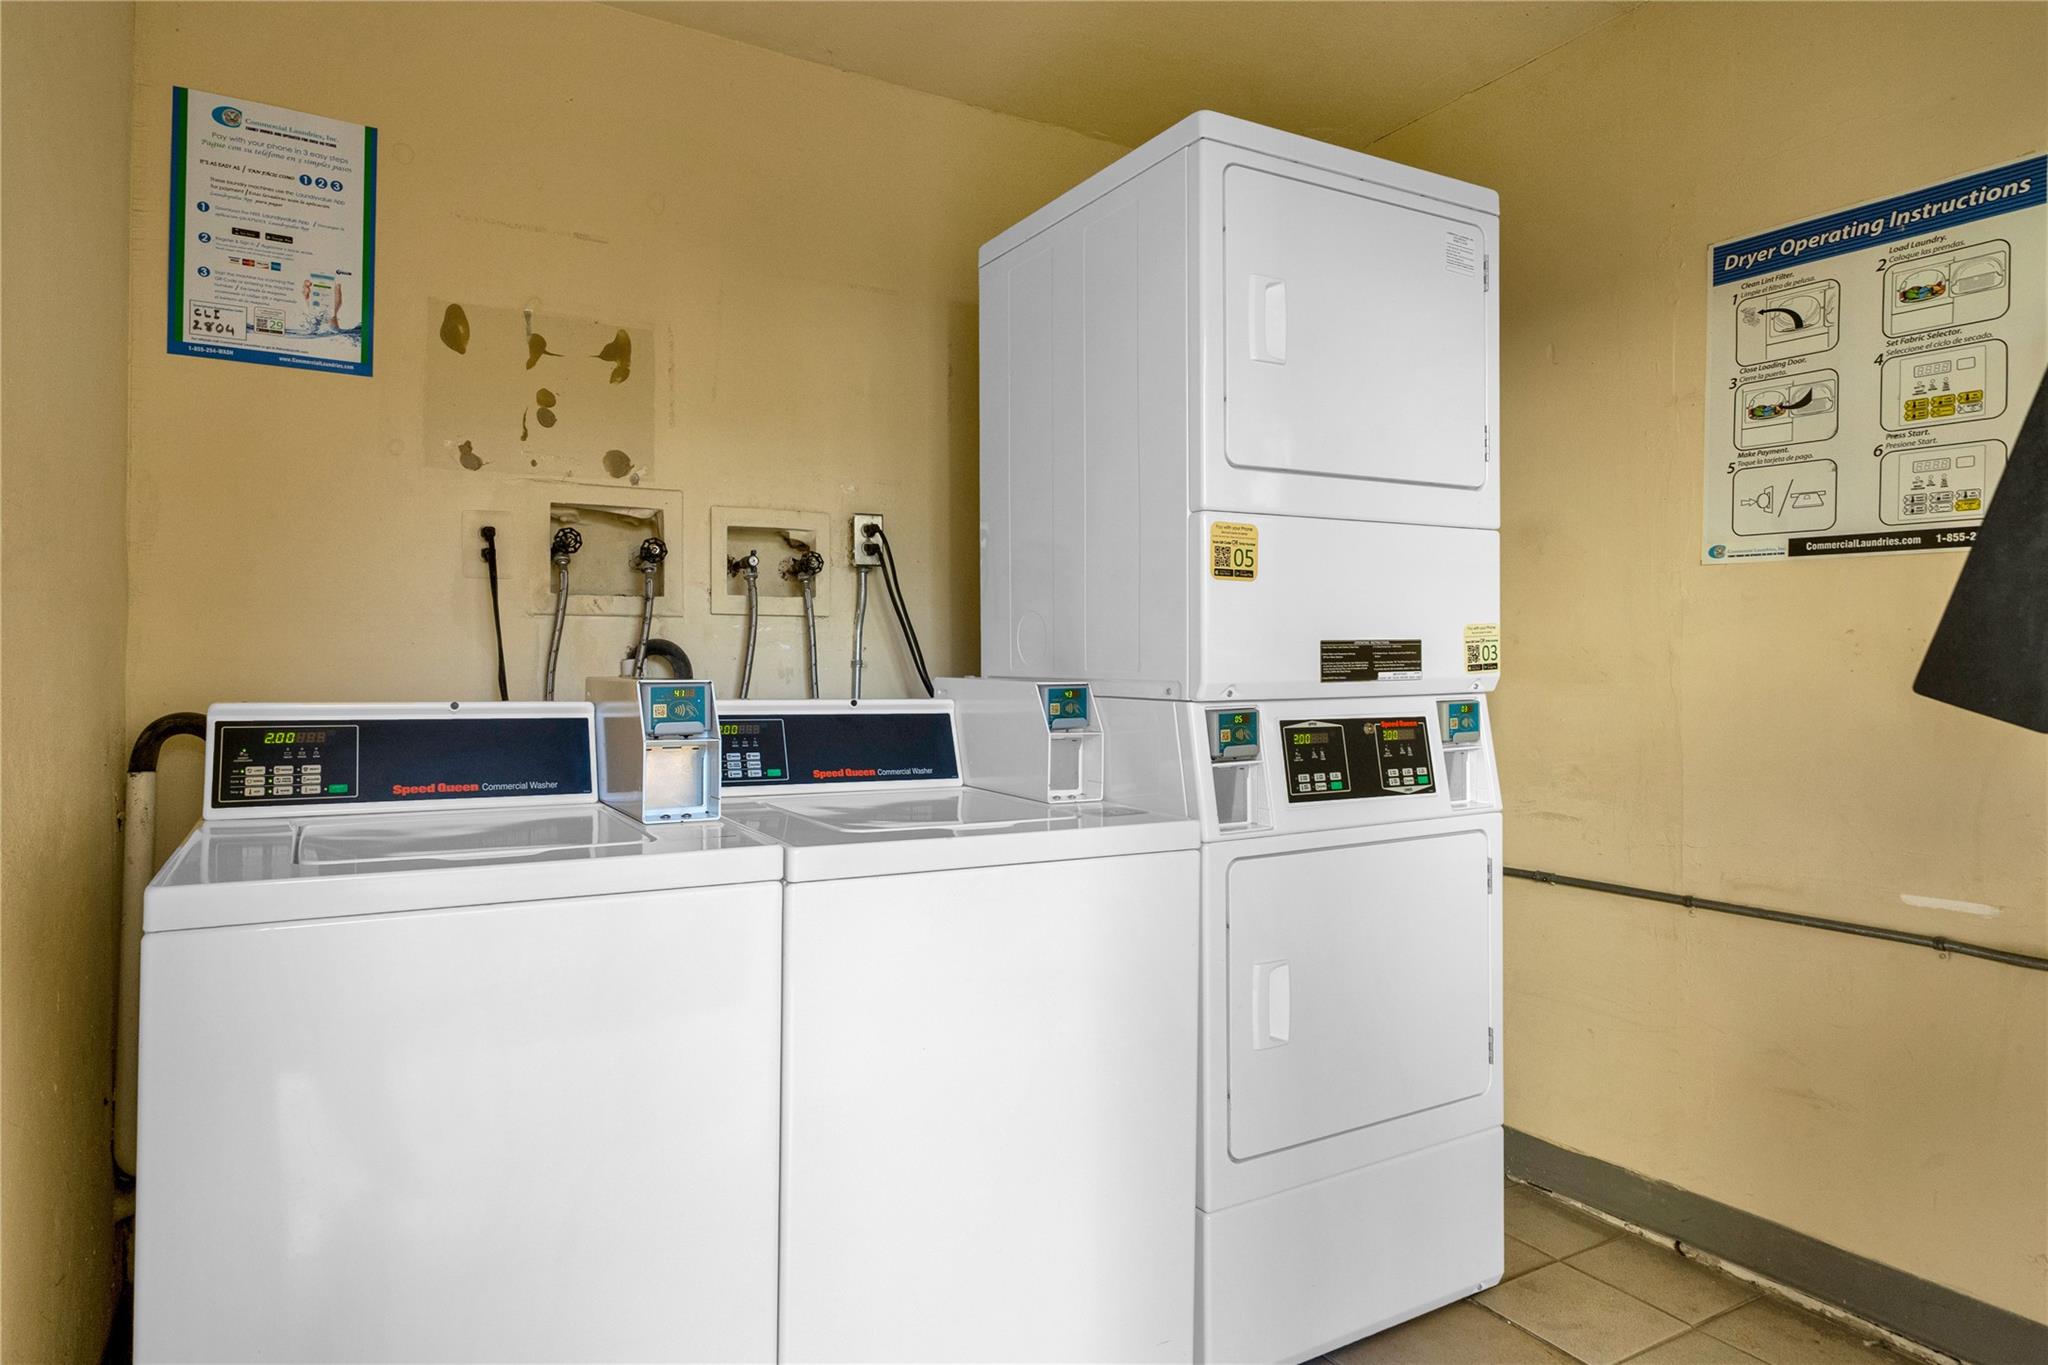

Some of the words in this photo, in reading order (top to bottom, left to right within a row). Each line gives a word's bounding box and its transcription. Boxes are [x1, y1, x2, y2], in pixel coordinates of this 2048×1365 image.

[245, 118, 288, 132] Commercial
[289, 126, 326, 140] Laundries,
[201, 139, 226, 149] Pague
[212, 132, 226, 141] Pay
[230, 134, 246, 144] with
[248, 138, 264, 148] your
[266, 142, 294, 152] phone
[294, 147, 302, 155] in
[302, 148, 308, 156] 3
[309, 151, 328, 161] easy
[329, 154, 349, 165] steps
[1724, 246, 1776, 271] Dryer
[1780, 218, 1884, 256] Operating
[1889, 178, 2032, 228] Instructions
[1889, 242, 1909, 254] Load
[1910, 235, 1947, 249] Laundry.
[1889, 252, 1920, 264] Coloque
[1920, 248, 1931, 256] las
[1932, 240, 1965, 253] prendas.
[1876, 258, 1887, 272] 2
[1741, 280, 1760, 290] Clean
[1761, 276, 1774, 285] Lint
[1775, 272, 1794, 281] Filter.
[1732, 294, 1738, 306] 1
[1741, 289, 1761, 299] Limpie
[194, 308, 220, 320] CLI
[192, 320, 235, 336] 2804
[269, 320, 284, 330] 29
[1886, 338, 1898, 348] Set
[1900, 334, 1925, 345] Fabric
[1926, 328, 1962, 340] Selector.
[1886, 345, 1924, 357] Seleccione
[1933, 339, 1952, 348] ciclo
[1952, 336, 1963, 345] de
[1963, 332, 1993, 342] secado.
[1739, 366, 1758, 374] Close
[1758, 362, 1786, 371] Loading
[1787, 357, 1807, 366] Door.
[1874, 353, 1884, 366] 4
[1739, 375, 1757, 383] Cierre
[1764, 370, 1787, 379] puerta.
[1729, 378, 1738, 390] 3
[1886, 432, 1906, 440] Press
[1907, 429, 1930, 438] Start.
[1874, 444, 1883, 457] 6
[1885, 441, 1916, 449] Presione
[1757, 447, 1789, 457] Payment.
[1764, 456, 1785, 465] tarjeta
[1794, 453, 1814, 461] pago.
[1727, 462, 1736, 474] 5
[1806, 536, 1922, 550] CommercialLaundries.com
[1234, 548, 1254, 567] 05
[1482, 645, 1498, 661] 03
[1380, 720, 1399, 728] Speed
[264, 732, 296, 744] 2.00
[813, 769, 844, 779] Speed
[845, 768, 876, 778] Queen
[877, 768, 911, 776] Commercial
[392, 783, 435, 795] Speed
[437, 782, 479, 792] Queen
[482, 781, 528, 791] Commercial
[529, 781, 558, 789] Washer
